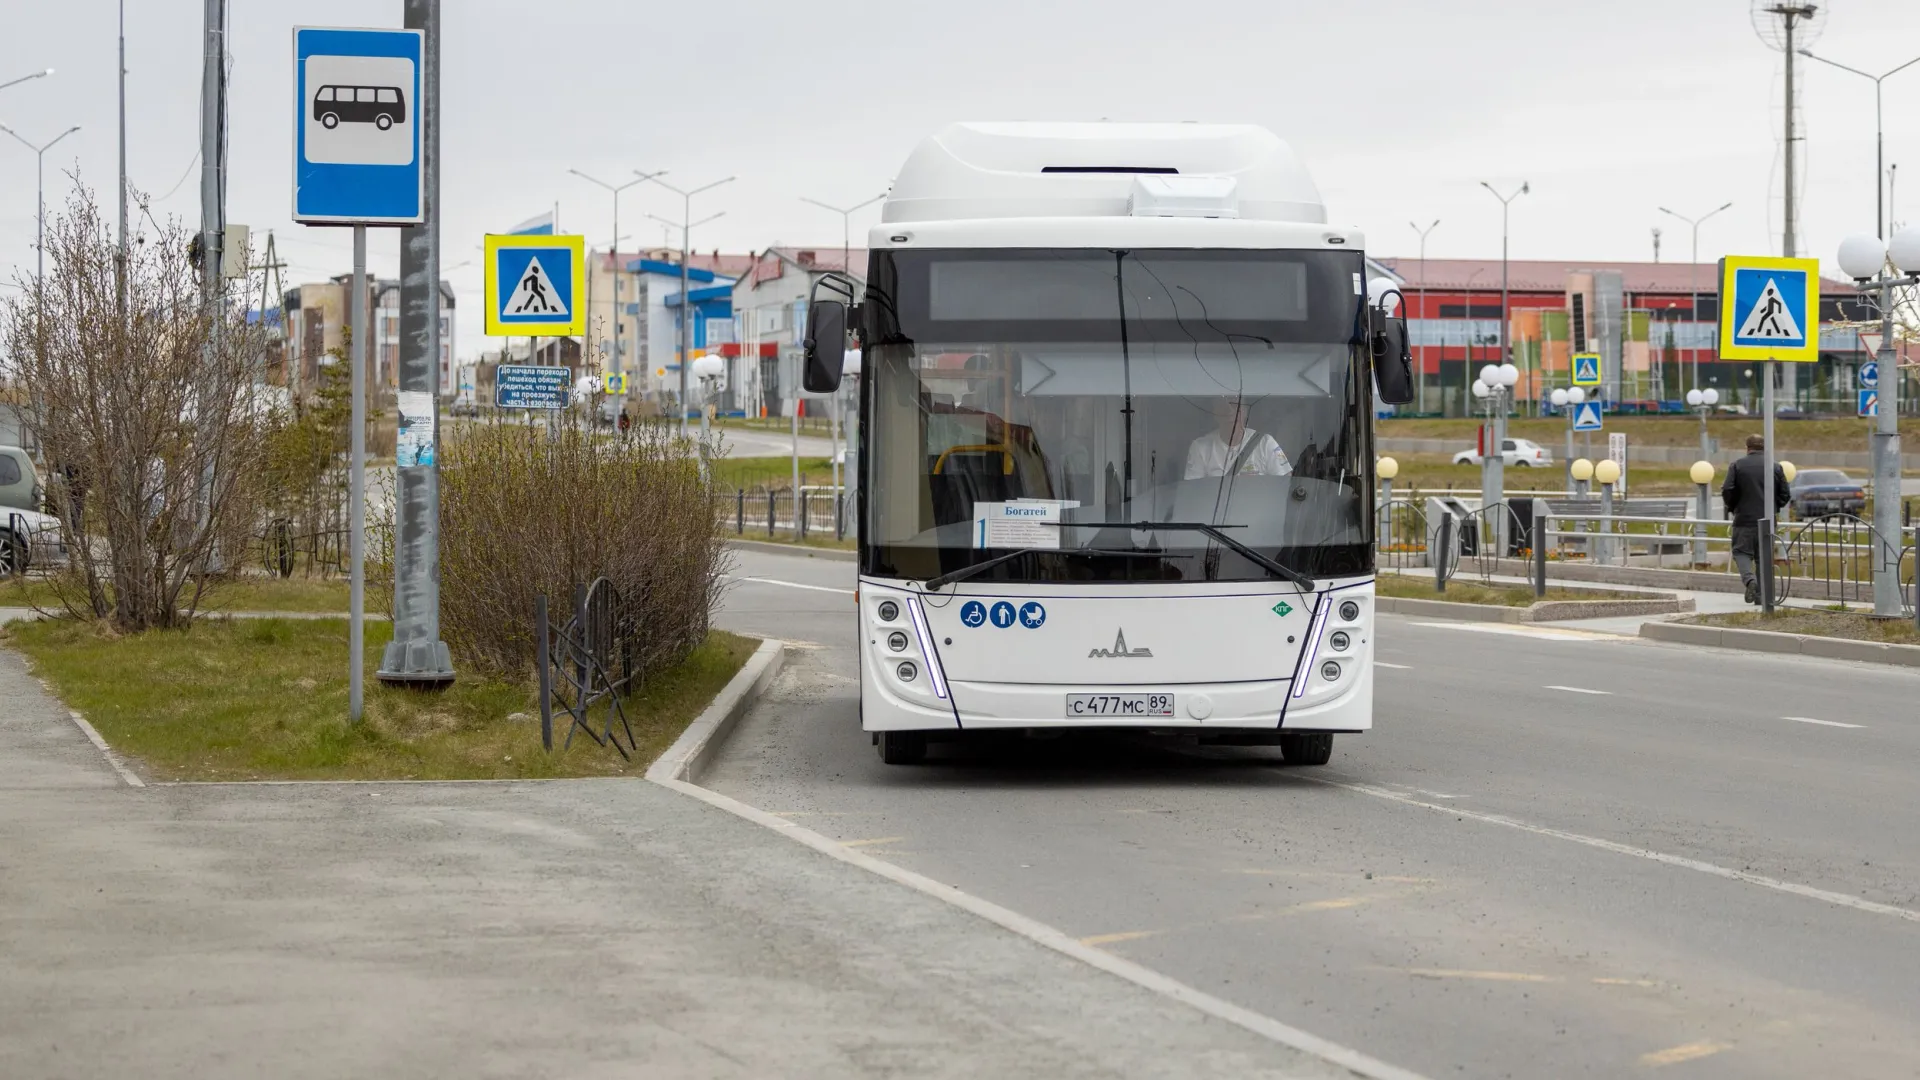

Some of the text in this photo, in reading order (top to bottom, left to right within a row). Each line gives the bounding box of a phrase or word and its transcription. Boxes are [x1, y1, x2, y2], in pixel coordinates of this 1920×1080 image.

[501, 367, 510, 375] До
[536, 368, 568, 376] перехода
[1004, 506, 1047, 516] Богатей
[976, 518, 986, 549] 1
[1275, 605, 1289, 613] КПГ
[1149, 695, 1168, 709] 89
